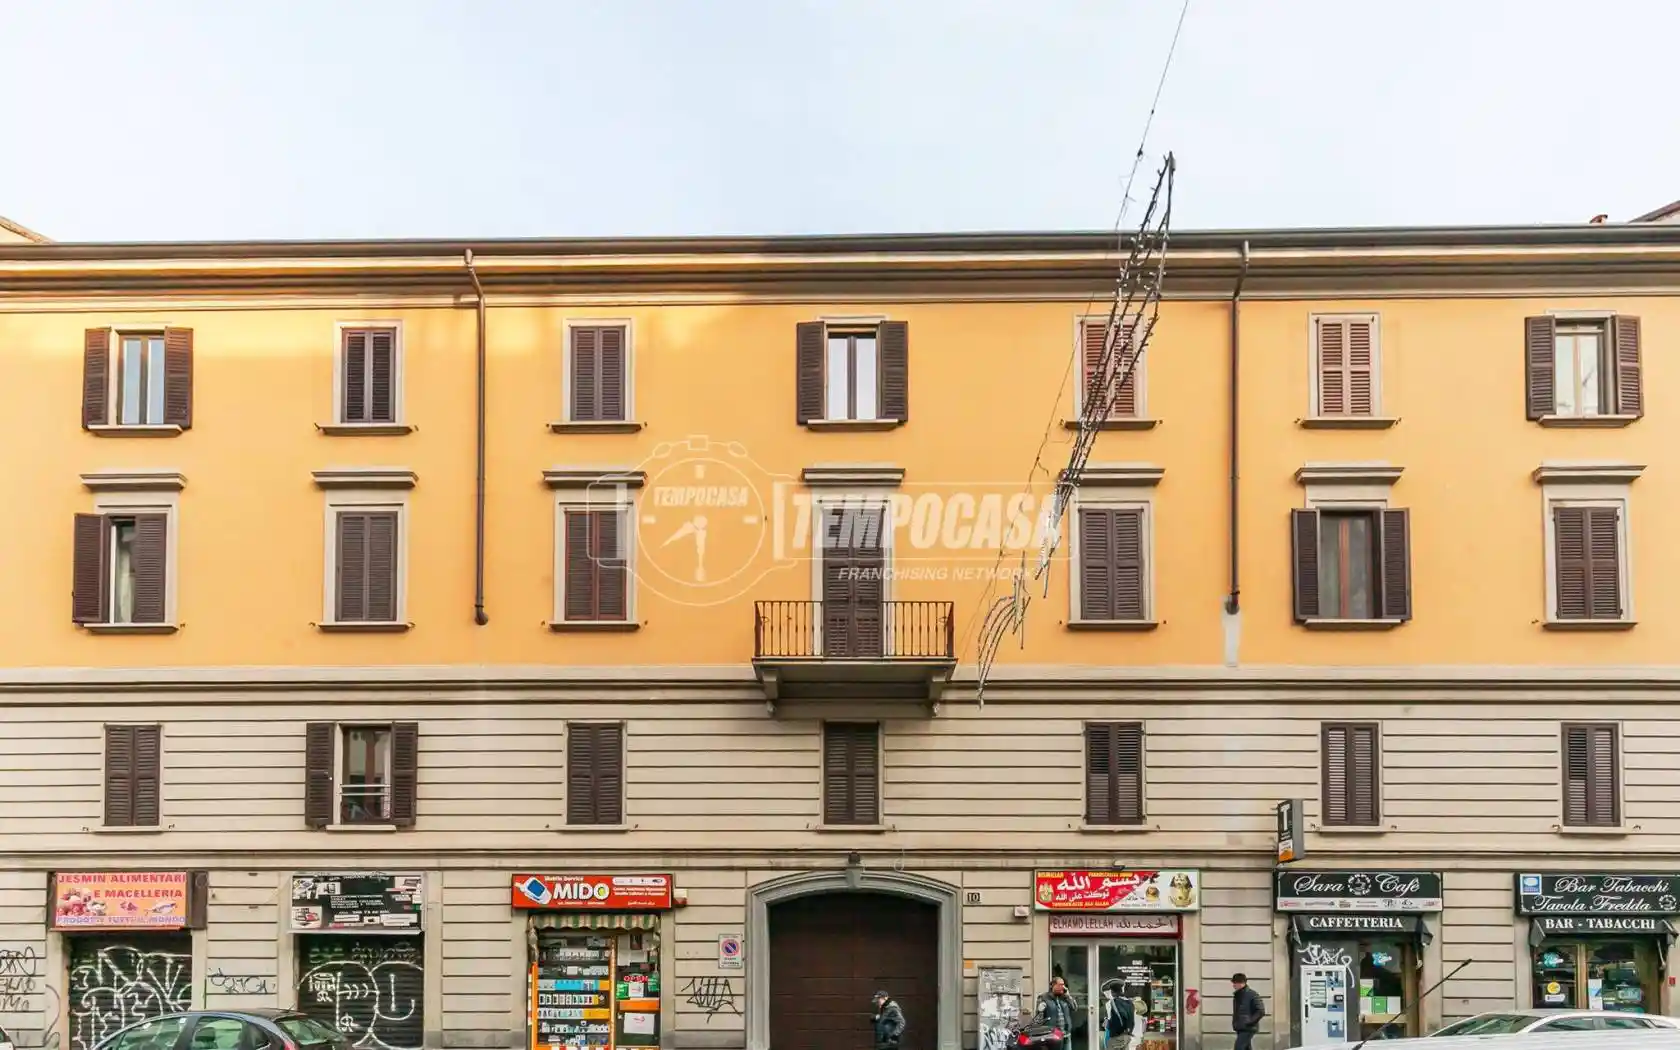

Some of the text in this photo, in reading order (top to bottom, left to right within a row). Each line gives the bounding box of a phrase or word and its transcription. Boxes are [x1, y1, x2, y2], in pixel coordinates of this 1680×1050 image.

[1280, 803, 1291, 832] T
[59, 874, 187, 883] JESMIN ALIMENTARI
[1098, 874, 1141, 890] بسم
[1293, 874, 1345, 896] Sara
[1554, 876, 1670, 893] Bar Tabacchi
[94, 889, 183, 898] E MACELLERIA
[553, 883, 610, 900] MIDO
[968, 893, 980, 902] 10
[1531, 895, 1651, 911] Tavola Fredda
[1052, 917, 1114, 930] ELHAMD LELLAH
[1309, 916, 1404, 929] CAFFETTERIA
[1545, 918, 1574, 929] BAR
[1586, 918, 1656, 930] TABACCHI
[623, 975, 649, 983] OPEN
